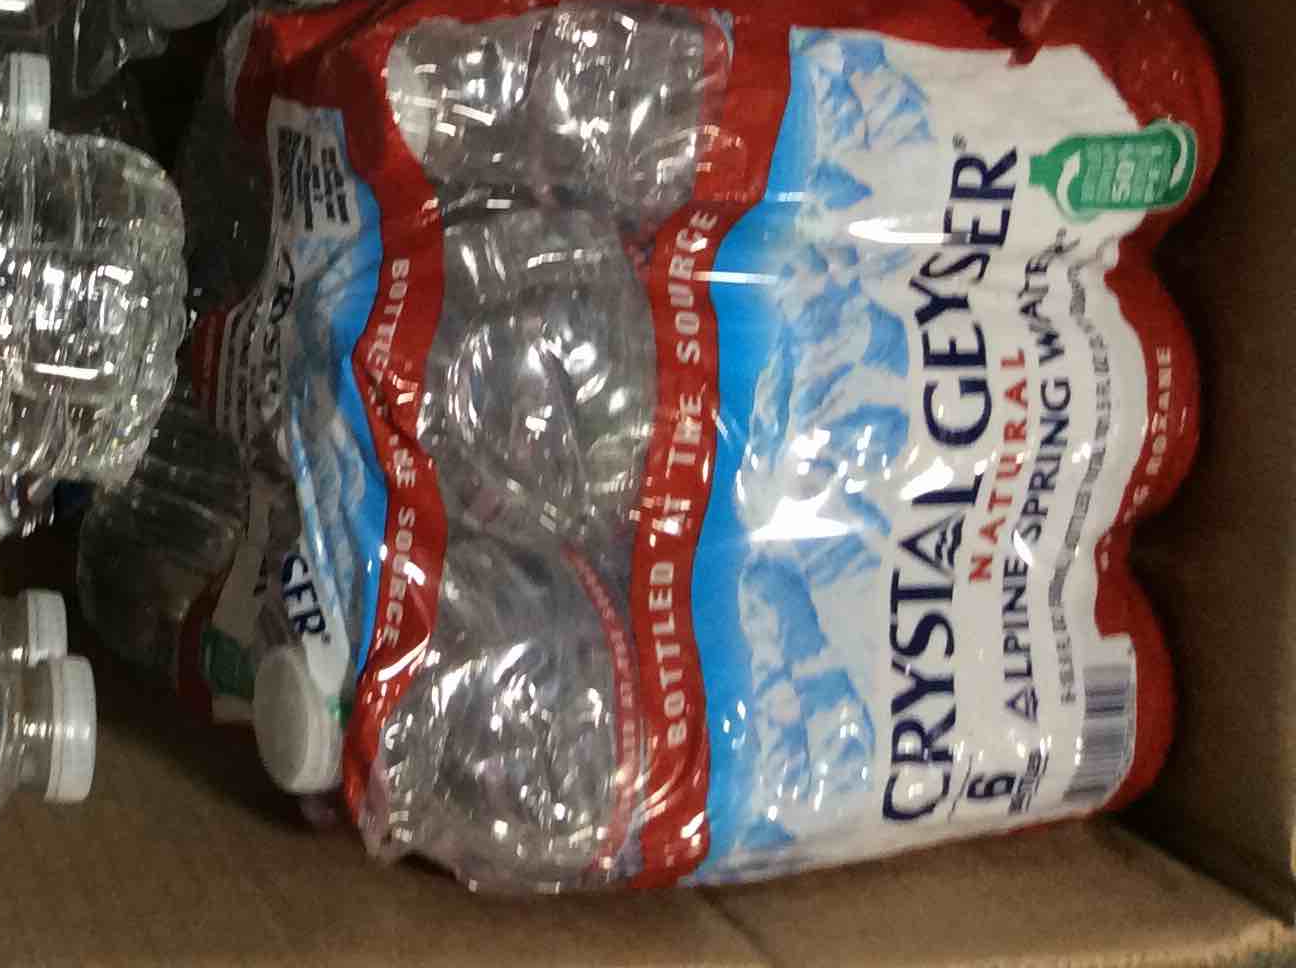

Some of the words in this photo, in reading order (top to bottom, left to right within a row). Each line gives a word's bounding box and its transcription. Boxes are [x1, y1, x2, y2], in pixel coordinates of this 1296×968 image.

[668, 210, 717, 365] SOURCE
[909, 147, 1017, 449] GEYSER
[666, 392, 703, 478] THE
[969, 348, 1027, 583] NATURAL
[1012, 377, 1072, 544] SPRING
[282, 553, 326, 634] SER
[386, 505, 415, 649] SOURCE
[648, 561, 687, 748] BOTTLED
[882, 472, 983, 821] CRYSTAL
[1002, 559, 1039, 722] ALPINE
[967, 773, 1015, 799] 6
